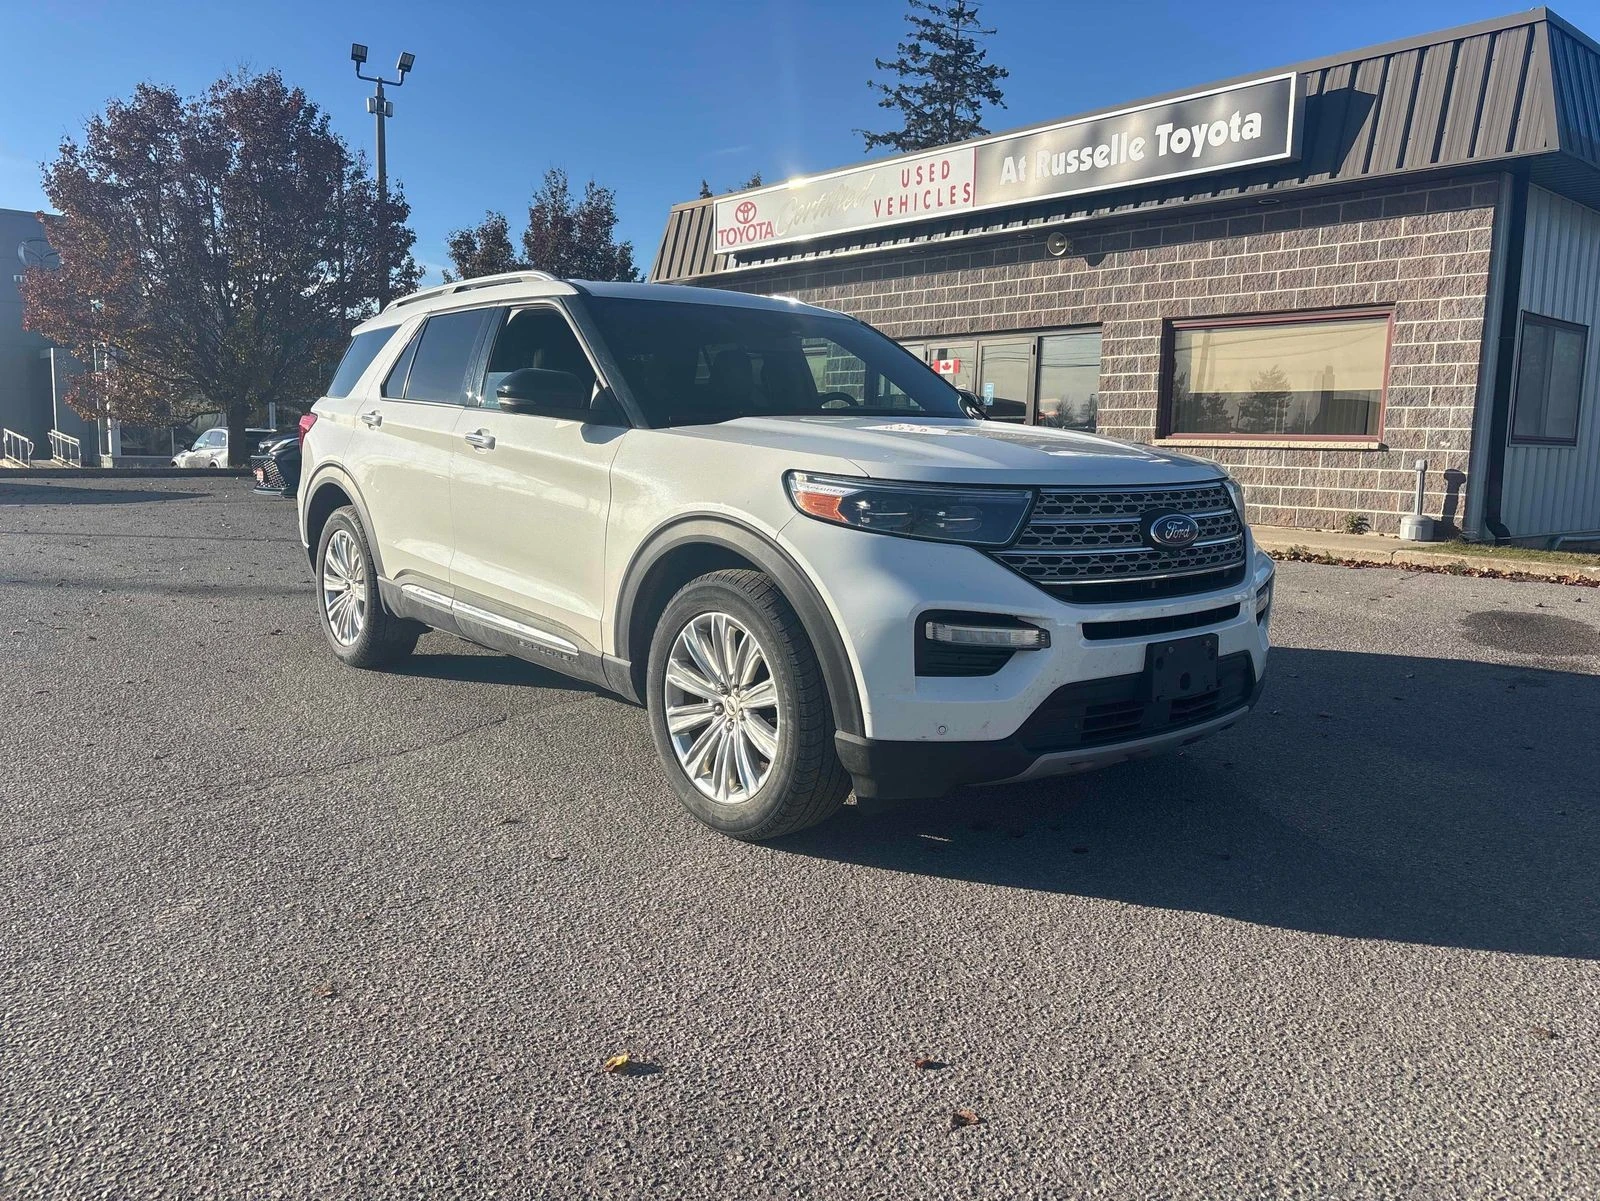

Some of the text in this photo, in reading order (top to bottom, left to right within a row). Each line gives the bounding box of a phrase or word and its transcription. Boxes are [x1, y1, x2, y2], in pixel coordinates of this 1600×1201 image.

[1000, 110, 1262, 185] At Russelle Toyota
[901, 160, 950, 188] USED
[873, 182, 971, 218] VEHICLES
[718, 221, 774, 246] TOYOTA
[1165, 520, 1191, 539] Ford
